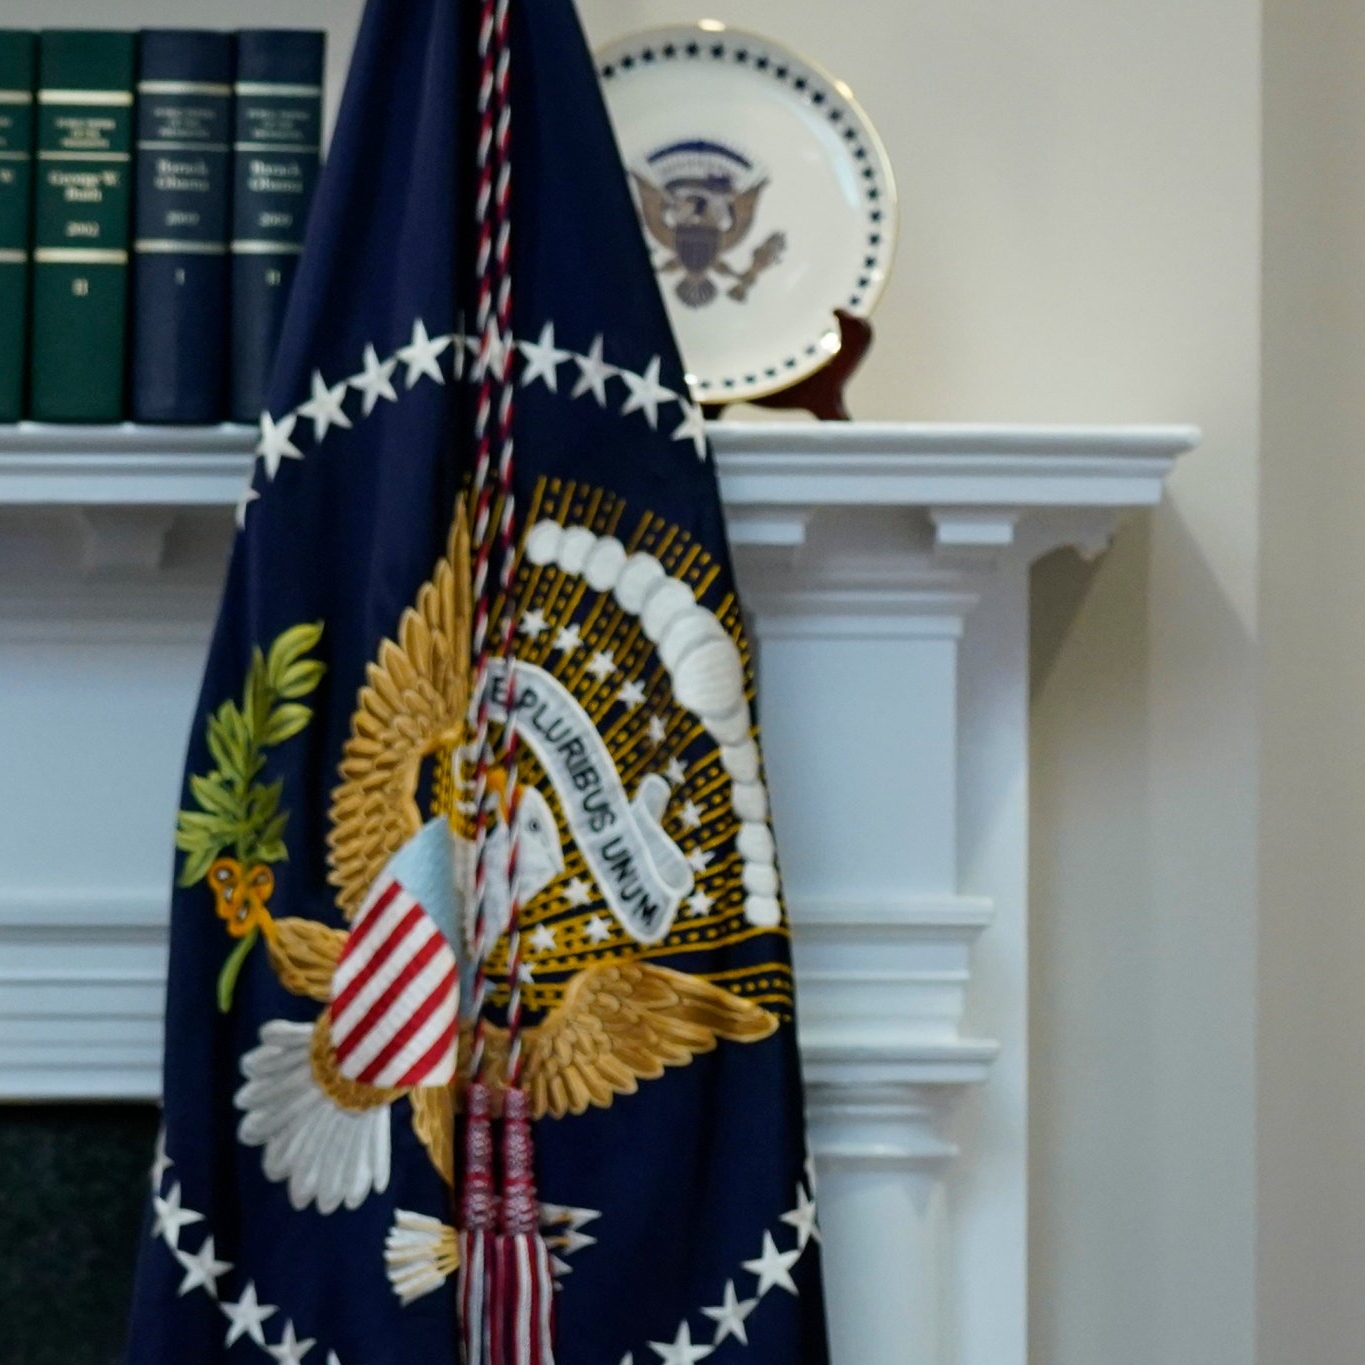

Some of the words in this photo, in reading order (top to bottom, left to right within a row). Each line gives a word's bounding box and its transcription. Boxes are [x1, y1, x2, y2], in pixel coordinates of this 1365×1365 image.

[490, 677, 511, 706] E
[513, 687, 617, 833] PLURIBUS
[600, 837, 659, 927] UNUM
